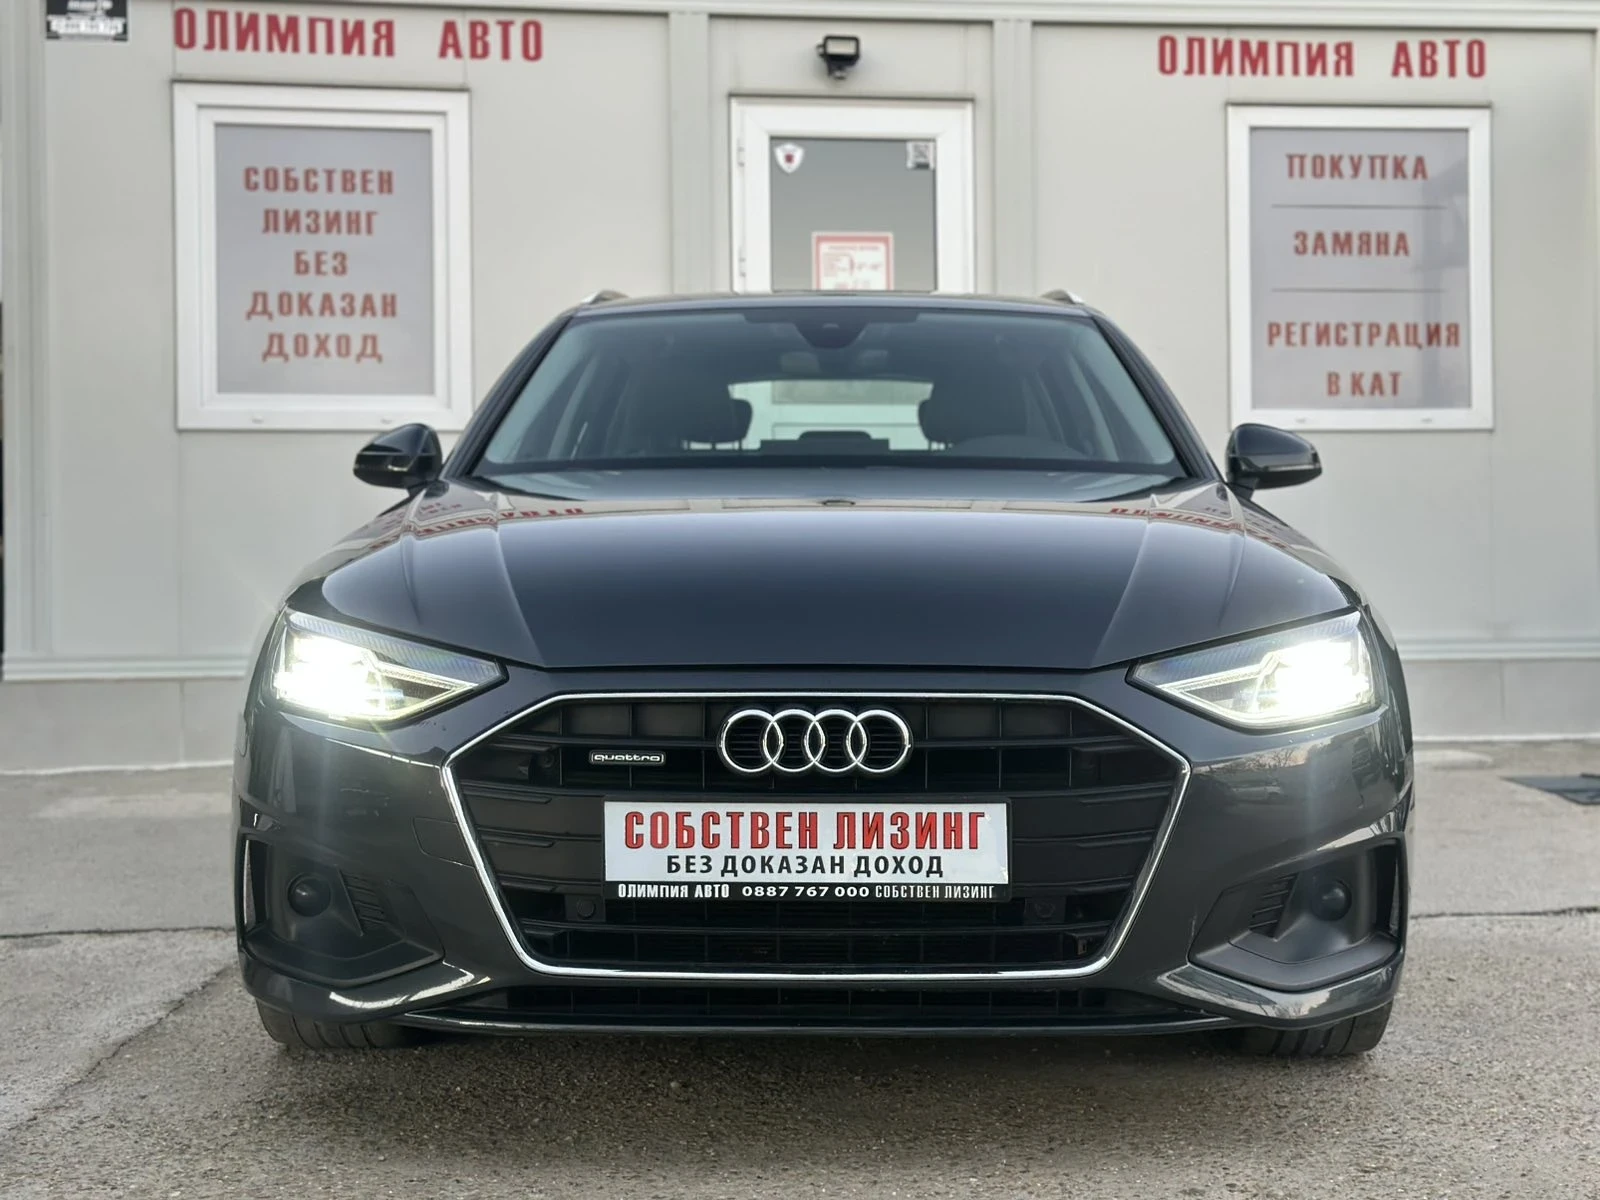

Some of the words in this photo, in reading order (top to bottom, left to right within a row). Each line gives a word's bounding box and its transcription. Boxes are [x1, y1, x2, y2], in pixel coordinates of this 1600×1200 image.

[173, 7, 396, 58] ОЛИМПИЯ
[438, 19, 544, 63] АВТО
[1157, 34, 1355, 78] ОЛИМПИЯ
[1391, 38, 1488, 80] АВТО
[243, 166, 394, 195] СОБСТВЕН
[1285, 154, 1428, 181] ПОКУПКА
[263, 209, 377, 236] ЛИЗИНГ
[1294, 230, 1410, 257] ЗАМЯНА
[294, 251, 348, 276] БЕЗ
[247, 291, 397, 320] ДОКАЗАН
[262, 332, 382, 363] ДОХОД
[1267, 321, 1461, 350] РЕГИСТРАЦИЯ
[1326, 372, 1341, 397] В
[1350, 372, 1401, 397] КАТ
[594, 754, 660, 762] quattro
[624, 811, 819, 850] СОБСТВЕН
[833, 811, 985, 850] ЛИЗИНГ
[667, 855, 713, 874] БЕЗ
[721, 855, 845, 877] ДОКАЗАН
[853, 855, 943, 877] ДОХОД
[617, 884, 689, 898] ОЛИМПИЯ
[694, 884, 730, 898] АВТО
[742, 885, 789, 897] 0887
[795, 886, 829, 897] 767
[835, 886, 870, 897] 000
[875, 885, 940, 899] СОБСТВЕН
[944, 885, 995, 899] ЛИЗИНГ
